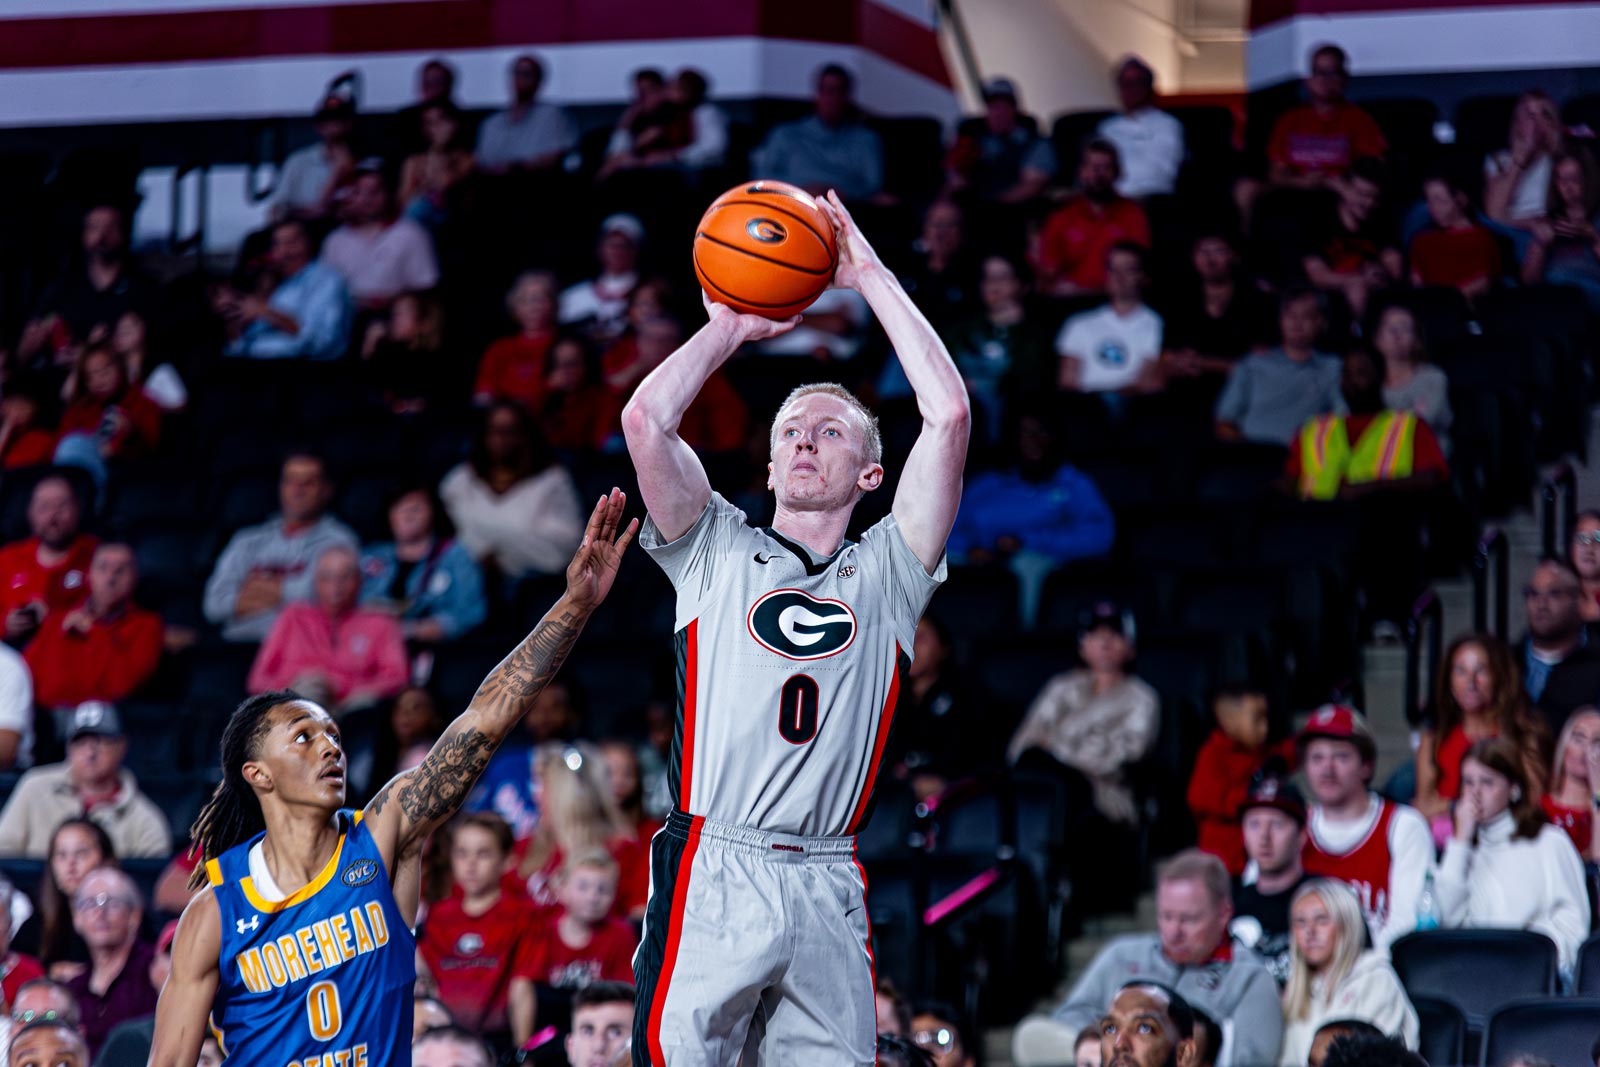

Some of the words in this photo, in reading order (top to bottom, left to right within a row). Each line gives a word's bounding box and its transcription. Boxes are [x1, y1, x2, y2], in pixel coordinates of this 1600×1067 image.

[839, 565, 854, 577] SEC
[747, 588, 858, 661] G
[778, 673, 819, 745] 0
[348, 863, 370, 882] OVC
[771, 843, 804, 853] GEORGIA
[236, 899, 390, 993] MOREHEAD
[306, 979, 342, 1042] 0
